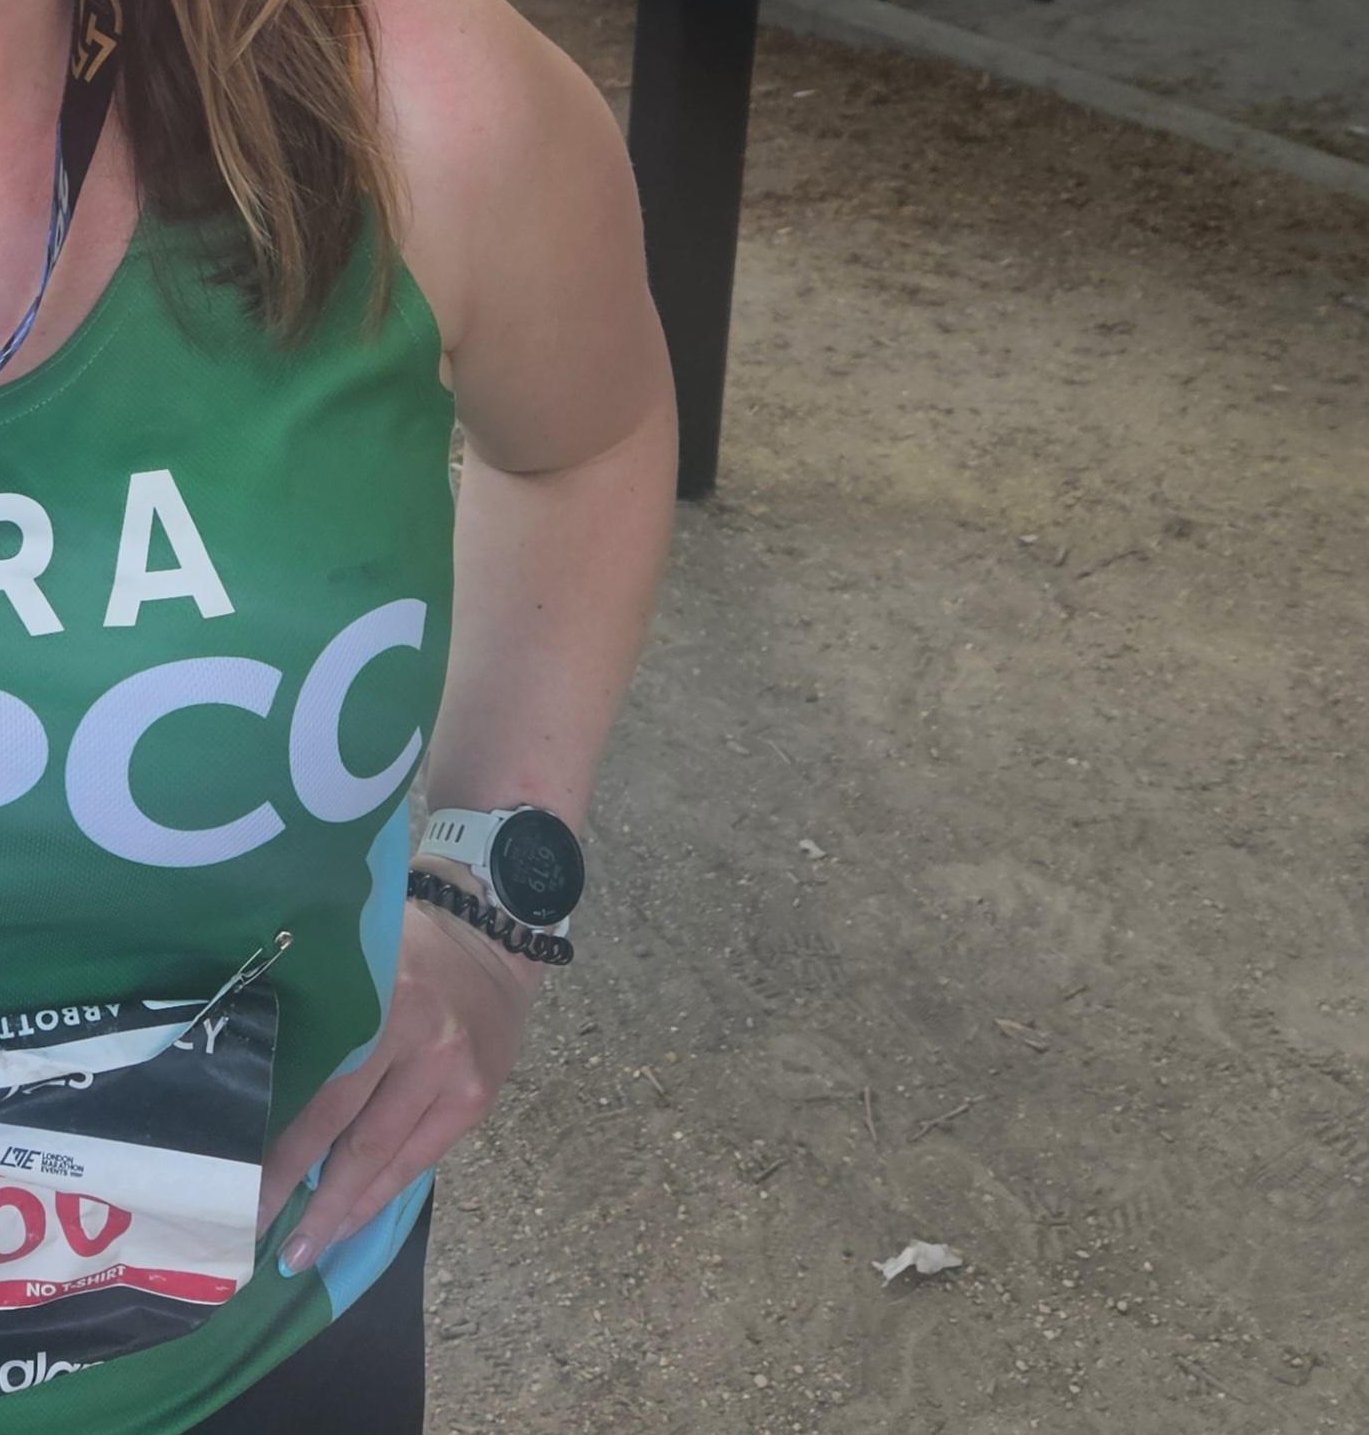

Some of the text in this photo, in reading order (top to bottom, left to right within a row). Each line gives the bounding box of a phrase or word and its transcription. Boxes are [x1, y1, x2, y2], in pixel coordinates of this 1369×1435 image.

[42, 1152, 74, 1164] LONDON
[41, 1165, 68, 1177] EVENTS
[25, 1282, 58, 1298] NO
[61, 1265, 128, 1293] T-SHIRT
